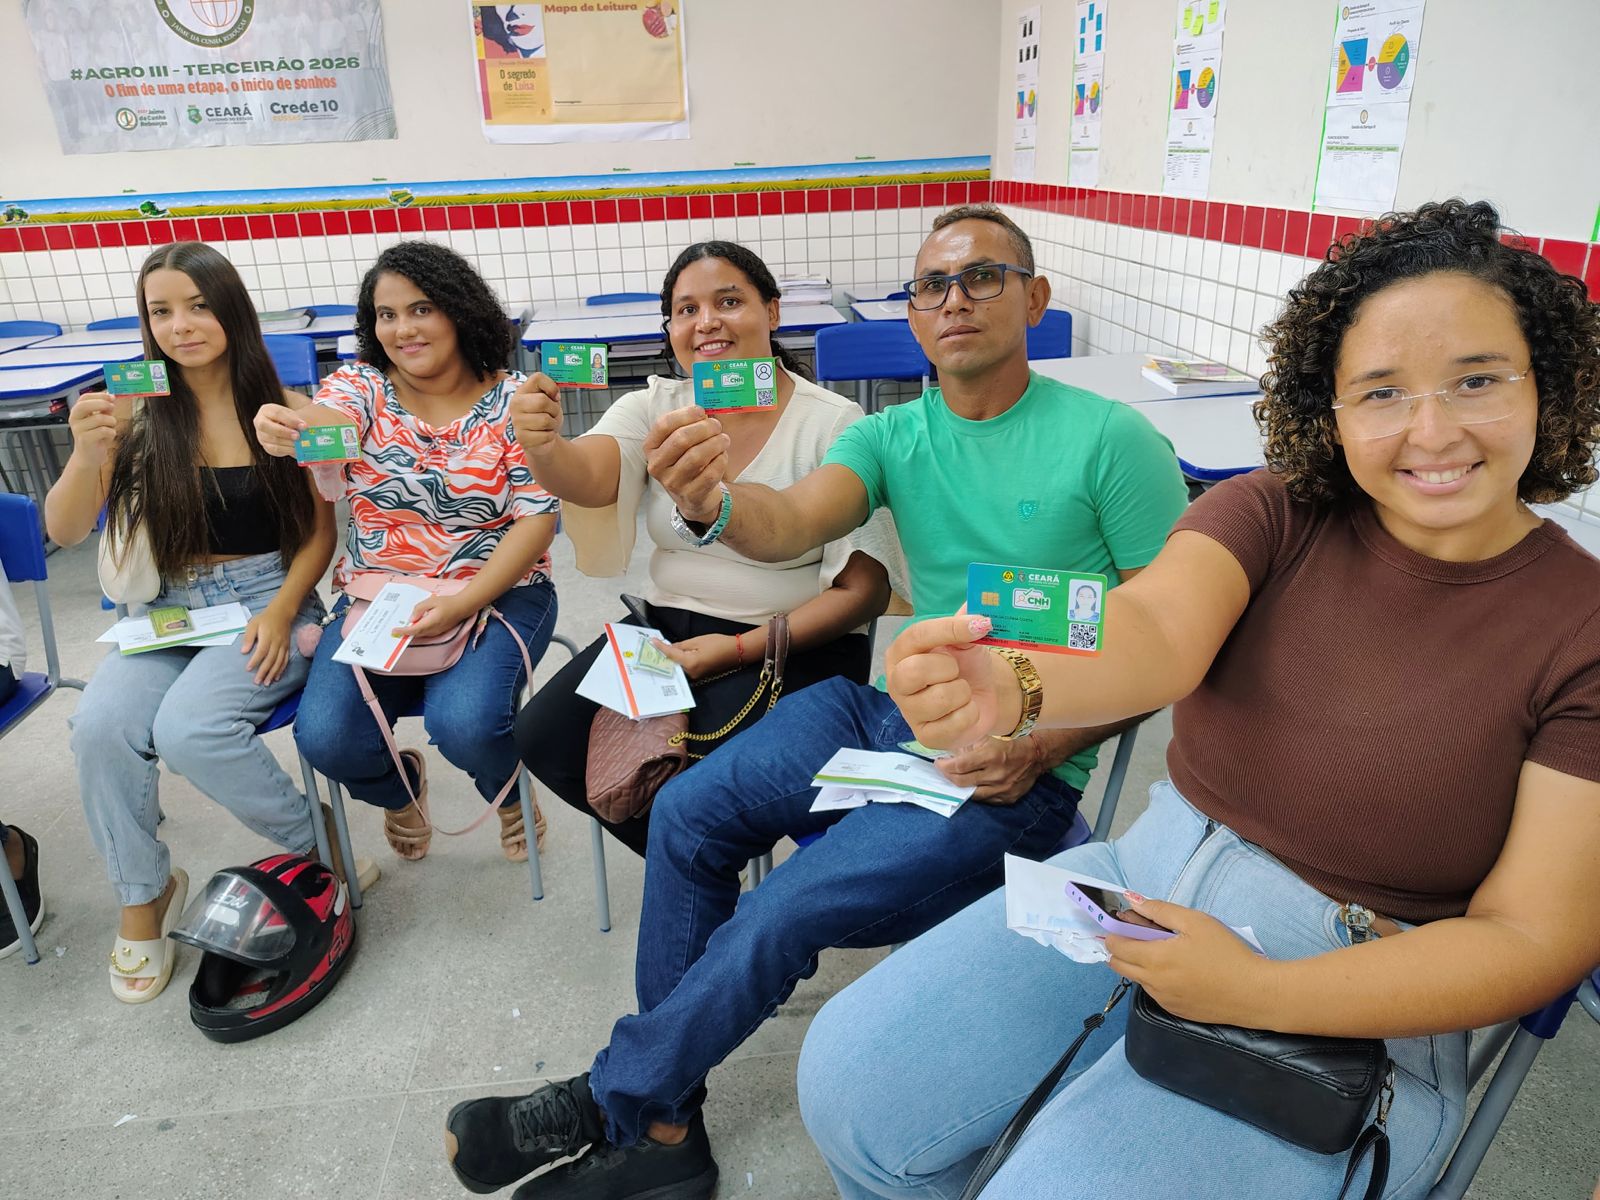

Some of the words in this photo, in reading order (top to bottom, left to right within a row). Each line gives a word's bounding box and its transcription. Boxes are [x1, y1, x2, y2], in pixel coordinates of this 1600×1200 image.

[545, 4, 577, 14] Mapa
[580, 3, 594, 12] de
[597, 1, 637, 11] Leitura
[170, 21, 190, 39] JAIME
[70, 66, 145, 81] #AGRO
[149, 65, 169, 77] III
[183, 57, 305, 76] TERCEIRÃO
[308, 56, 360, 70] 2026
[500, 69, 505, 79] O
[507, 69, 537, 81] segredo
[104, 84, 115, 98] O
[116, 83, 139, 97] fim
[140, 82, 156, 96] de
[157, 82, 185, 95] uma
[188, 80, 229, 95] etapa,
[230, 82, 239, 92] o
[276, 76, 292, 90] de
[294, 75, 337, 90] sonhos
[503, 81, 513, 91] de
[205, 102, 253, 117] CEARÁ
[270, 100, 319, 114] Crede
[320, 99, 339, 112] 10
[1028, 573, 1060, 582] CEARÁ
[1027, 597, 1049, 606] CNH
